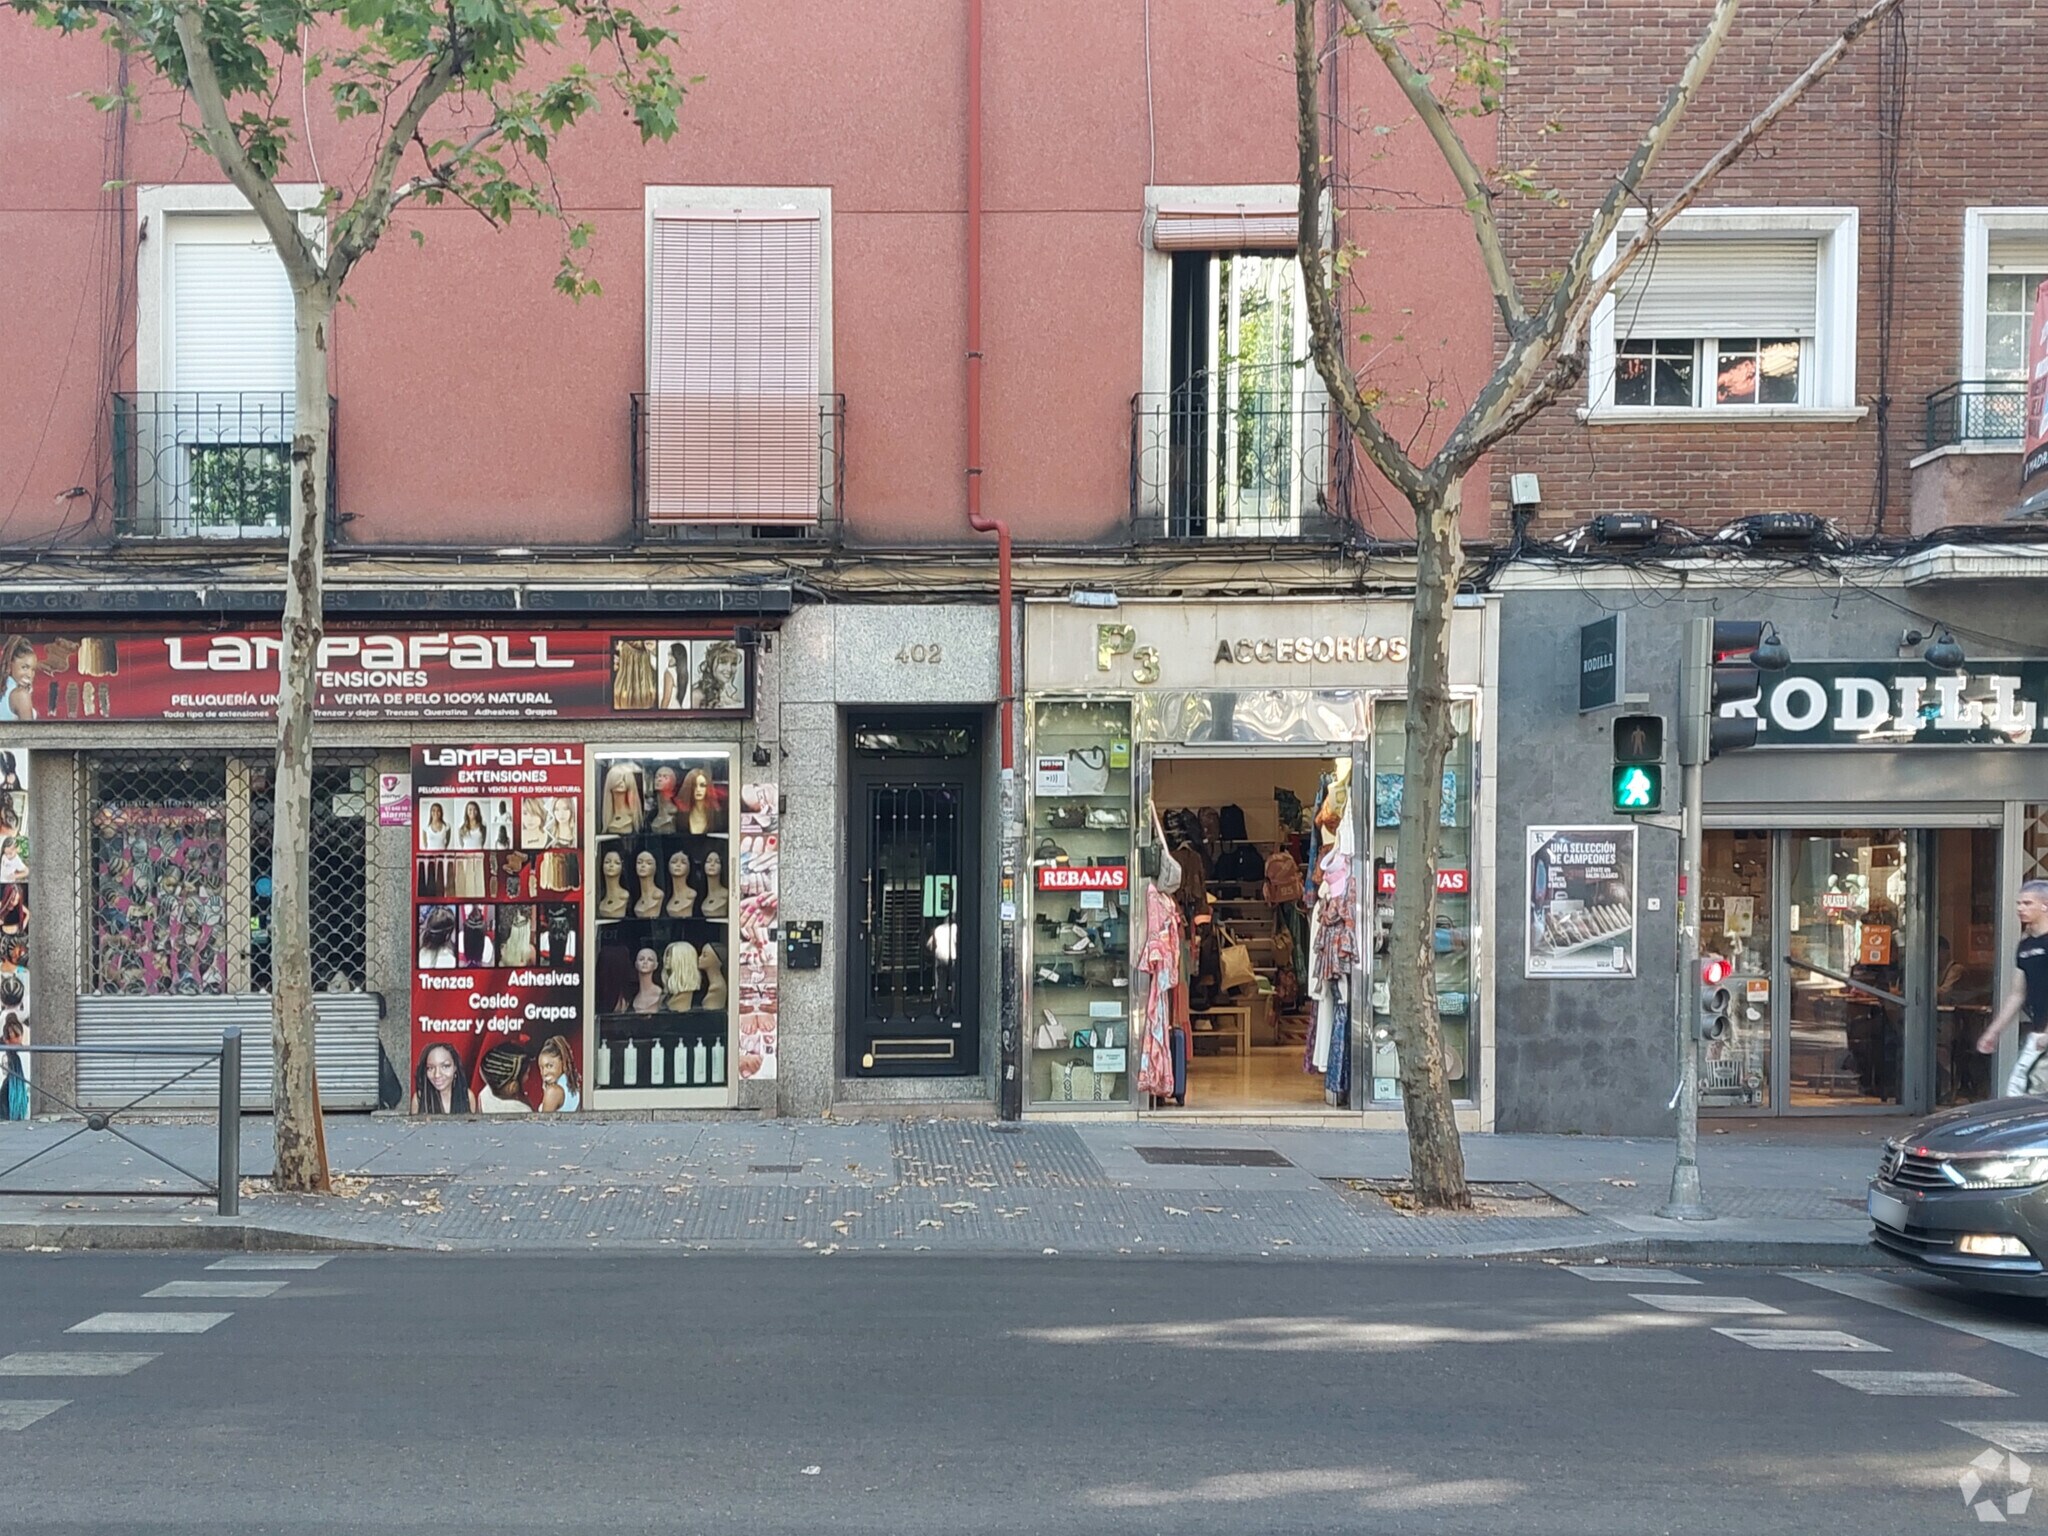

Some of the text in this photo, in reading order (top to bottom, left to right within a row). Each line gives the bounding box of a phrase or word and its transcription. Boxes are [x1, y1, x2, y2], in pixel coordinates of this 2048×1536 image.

[459, 593, 554, 607] GRANES
[894, 643, 942, 664] 402
[1214, 635, 1408, 664] ACCESORIOS
[1583, 652, 1614, 673] RODILLA
[315, 671, 427, 687] TENSIONES
[171, 691, 257, 706] PELUQUERÍA
[334, 693, 381, 705] VENTA
[383, 693, 402, 704] DE
[405, 693, 441, 704] PELO
[443, 693, 485, 704] 100%
[488, 693, 553, 704] NATURAL
[1719, 676, 2048, 731] ODILL
[163, 710, 185, 718] Todo
[186, 710, 204, 719] tipo
[205, 710, 217, 718] de
[314, 709, 346, 717] Trenzar
[355, 708, 379, 718] dejar
[384, 709, 419, 717] Trenzas
[423, 708, 468, 717] Queratina
[474, 708, 520, 716] Adhesivas
[524, 708, 558, 717] Grapas
[458, 770, 548, 783] EXTENSIONES
[1550, 841, 1616, 853] UNA SELECCIÓN
[1550, 854, 1616, 864] DE CAMPEONES
[1043, 870, 1124, 886] REBAJAS
[1383, 873, 1463, 888] RJAS
[418, 973, 474, 989] Trenzas
[508, 970, 580, 986] Adhesivas
[469, 993, 519, 1009] Cosido
[524, 1003, 577, 1022] Grapas
[418, 1015, 524, 1035] Trenzar y dejar
